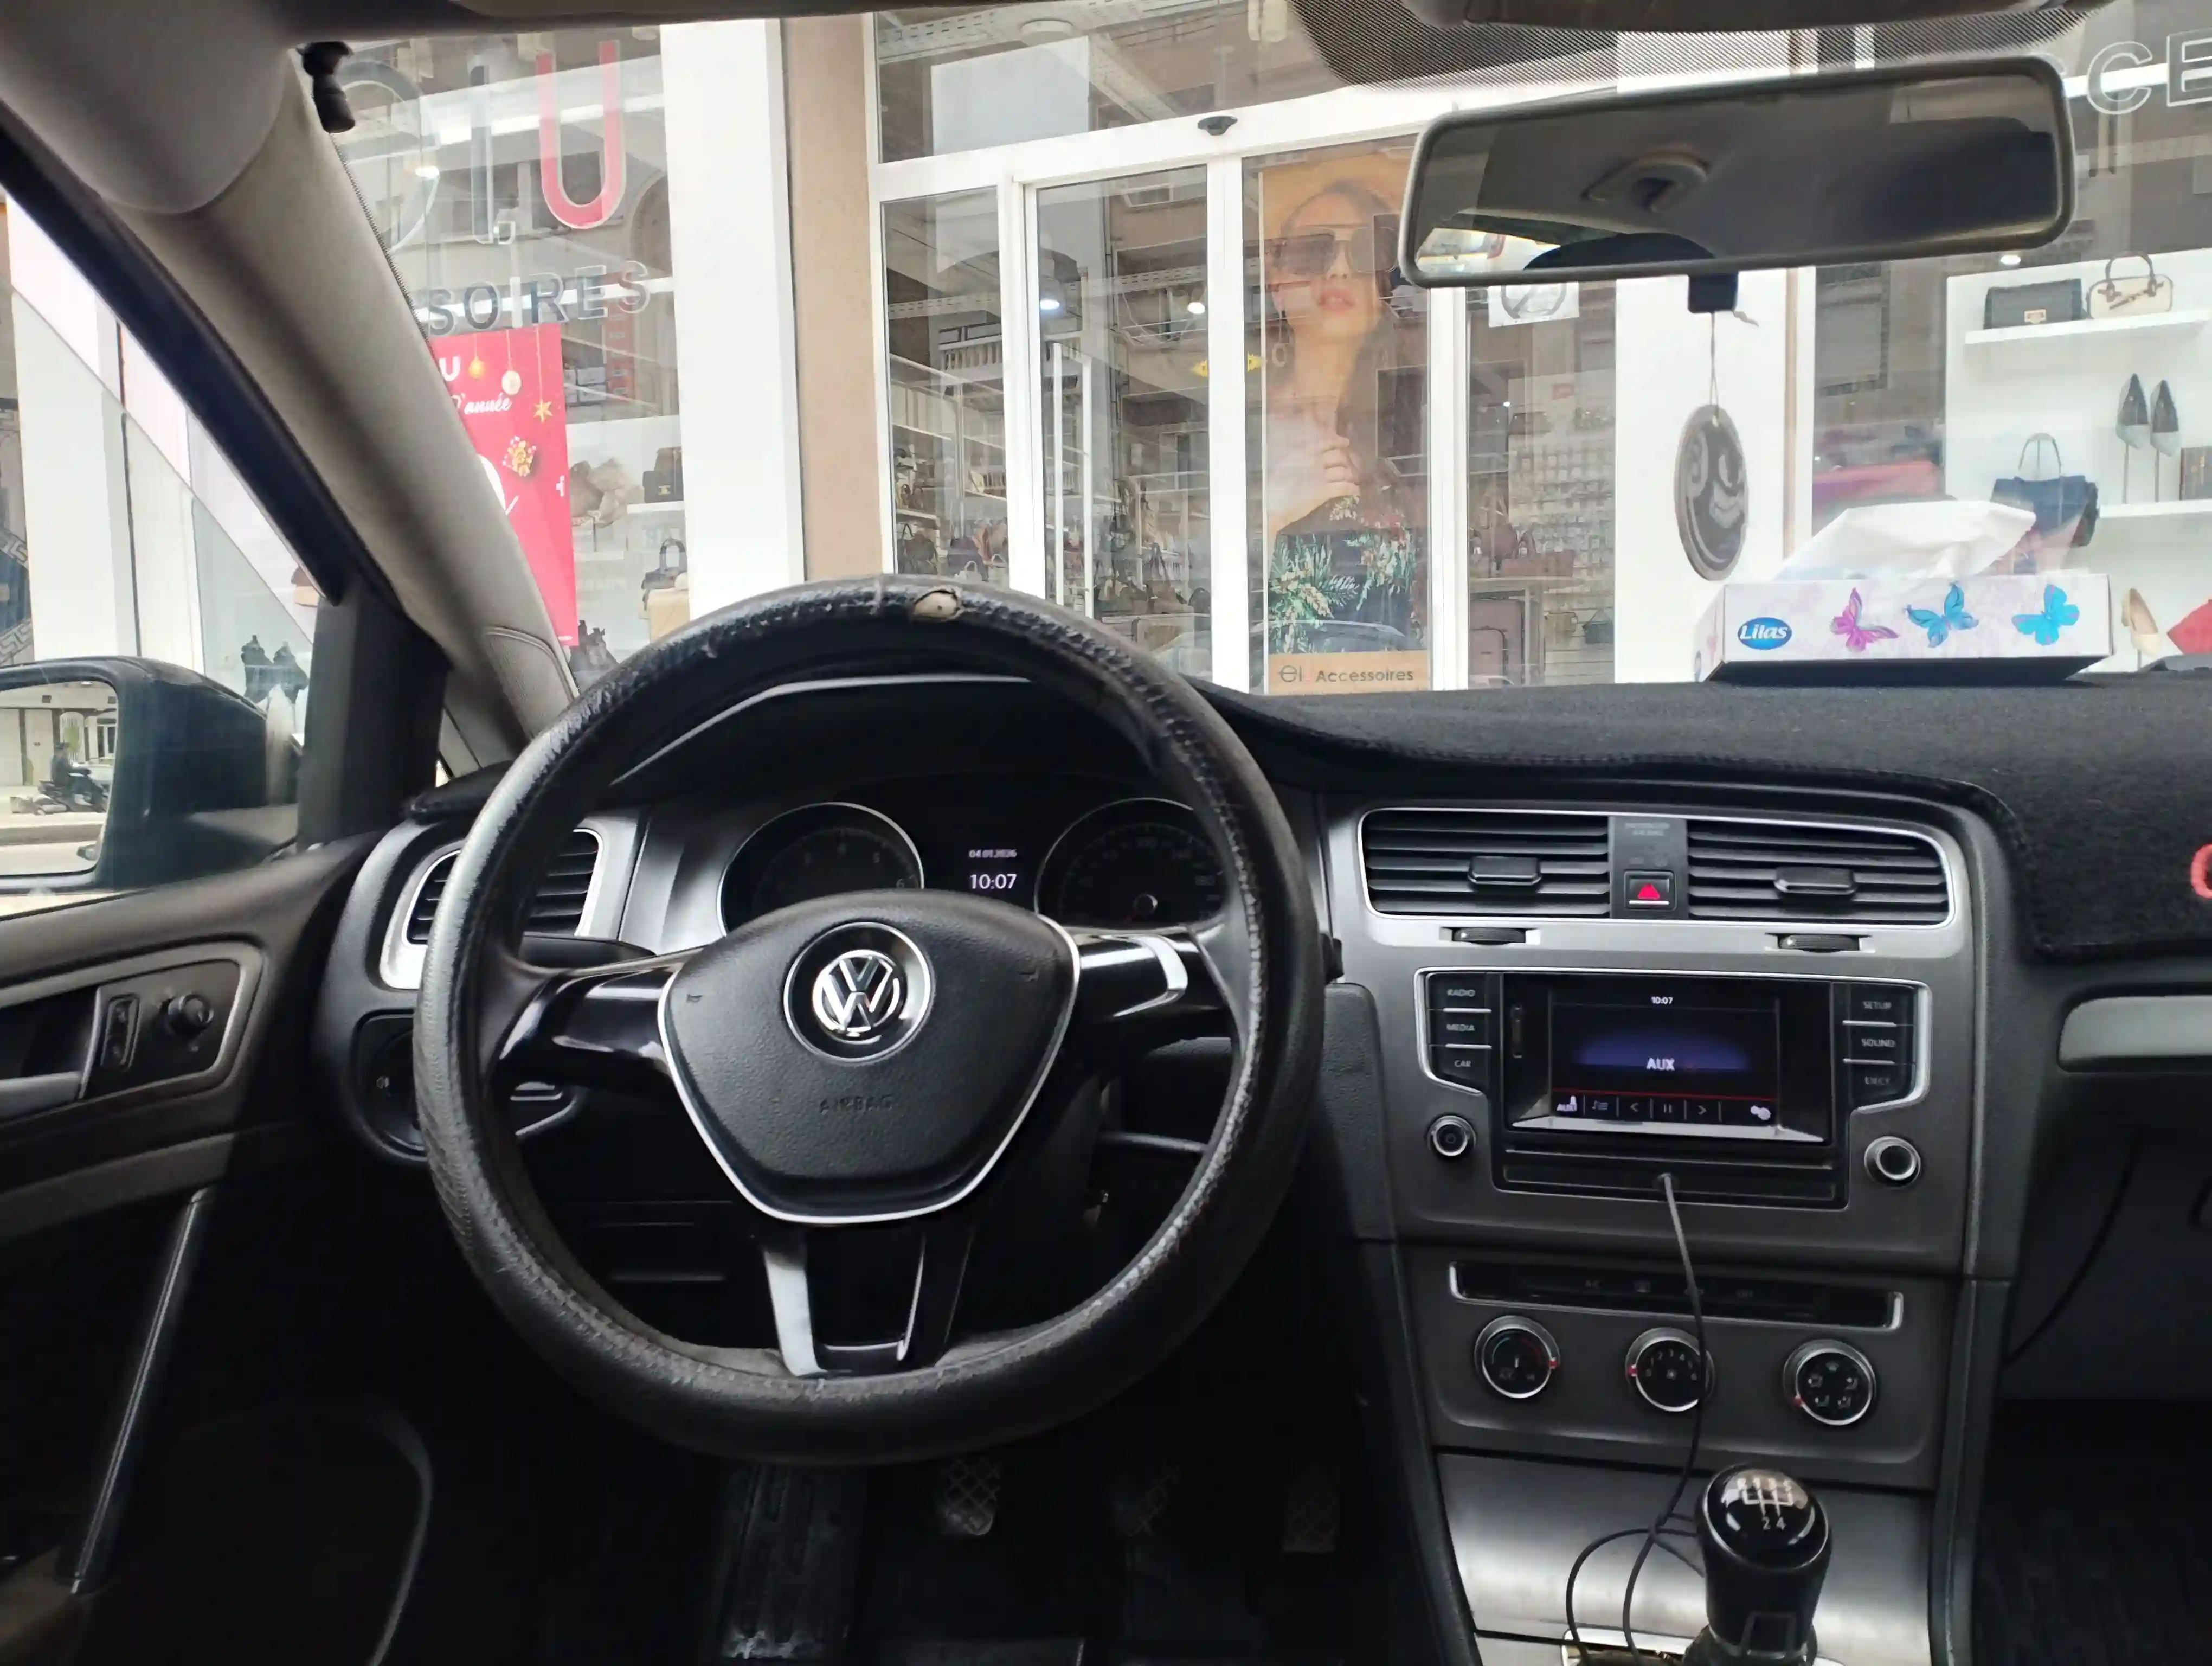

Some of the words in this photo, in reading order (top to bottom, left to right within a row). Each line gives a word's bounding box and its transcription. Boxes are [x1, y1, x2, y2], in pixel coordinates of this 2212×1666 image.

[2033, 28, 2212, 115] CE
[1739, 624, 1789, 640] Lilas
[1315, 667, 1414, 682] Accessoires
[970, 873, 1018, 889] 10:07
[1446, 989, 1476, 997] RADIO
[1651, 996, 1673, 1005] 10:07
[1446, 1023, 1475, 1031] MEDIA
[1454, 1060, 1471, 1068] CAR
[1646, 1057, 1675, 1071] AUX
[1763, 1516, 1771, 1530] 2
[1776, 1516, 1786, 1530] 4
